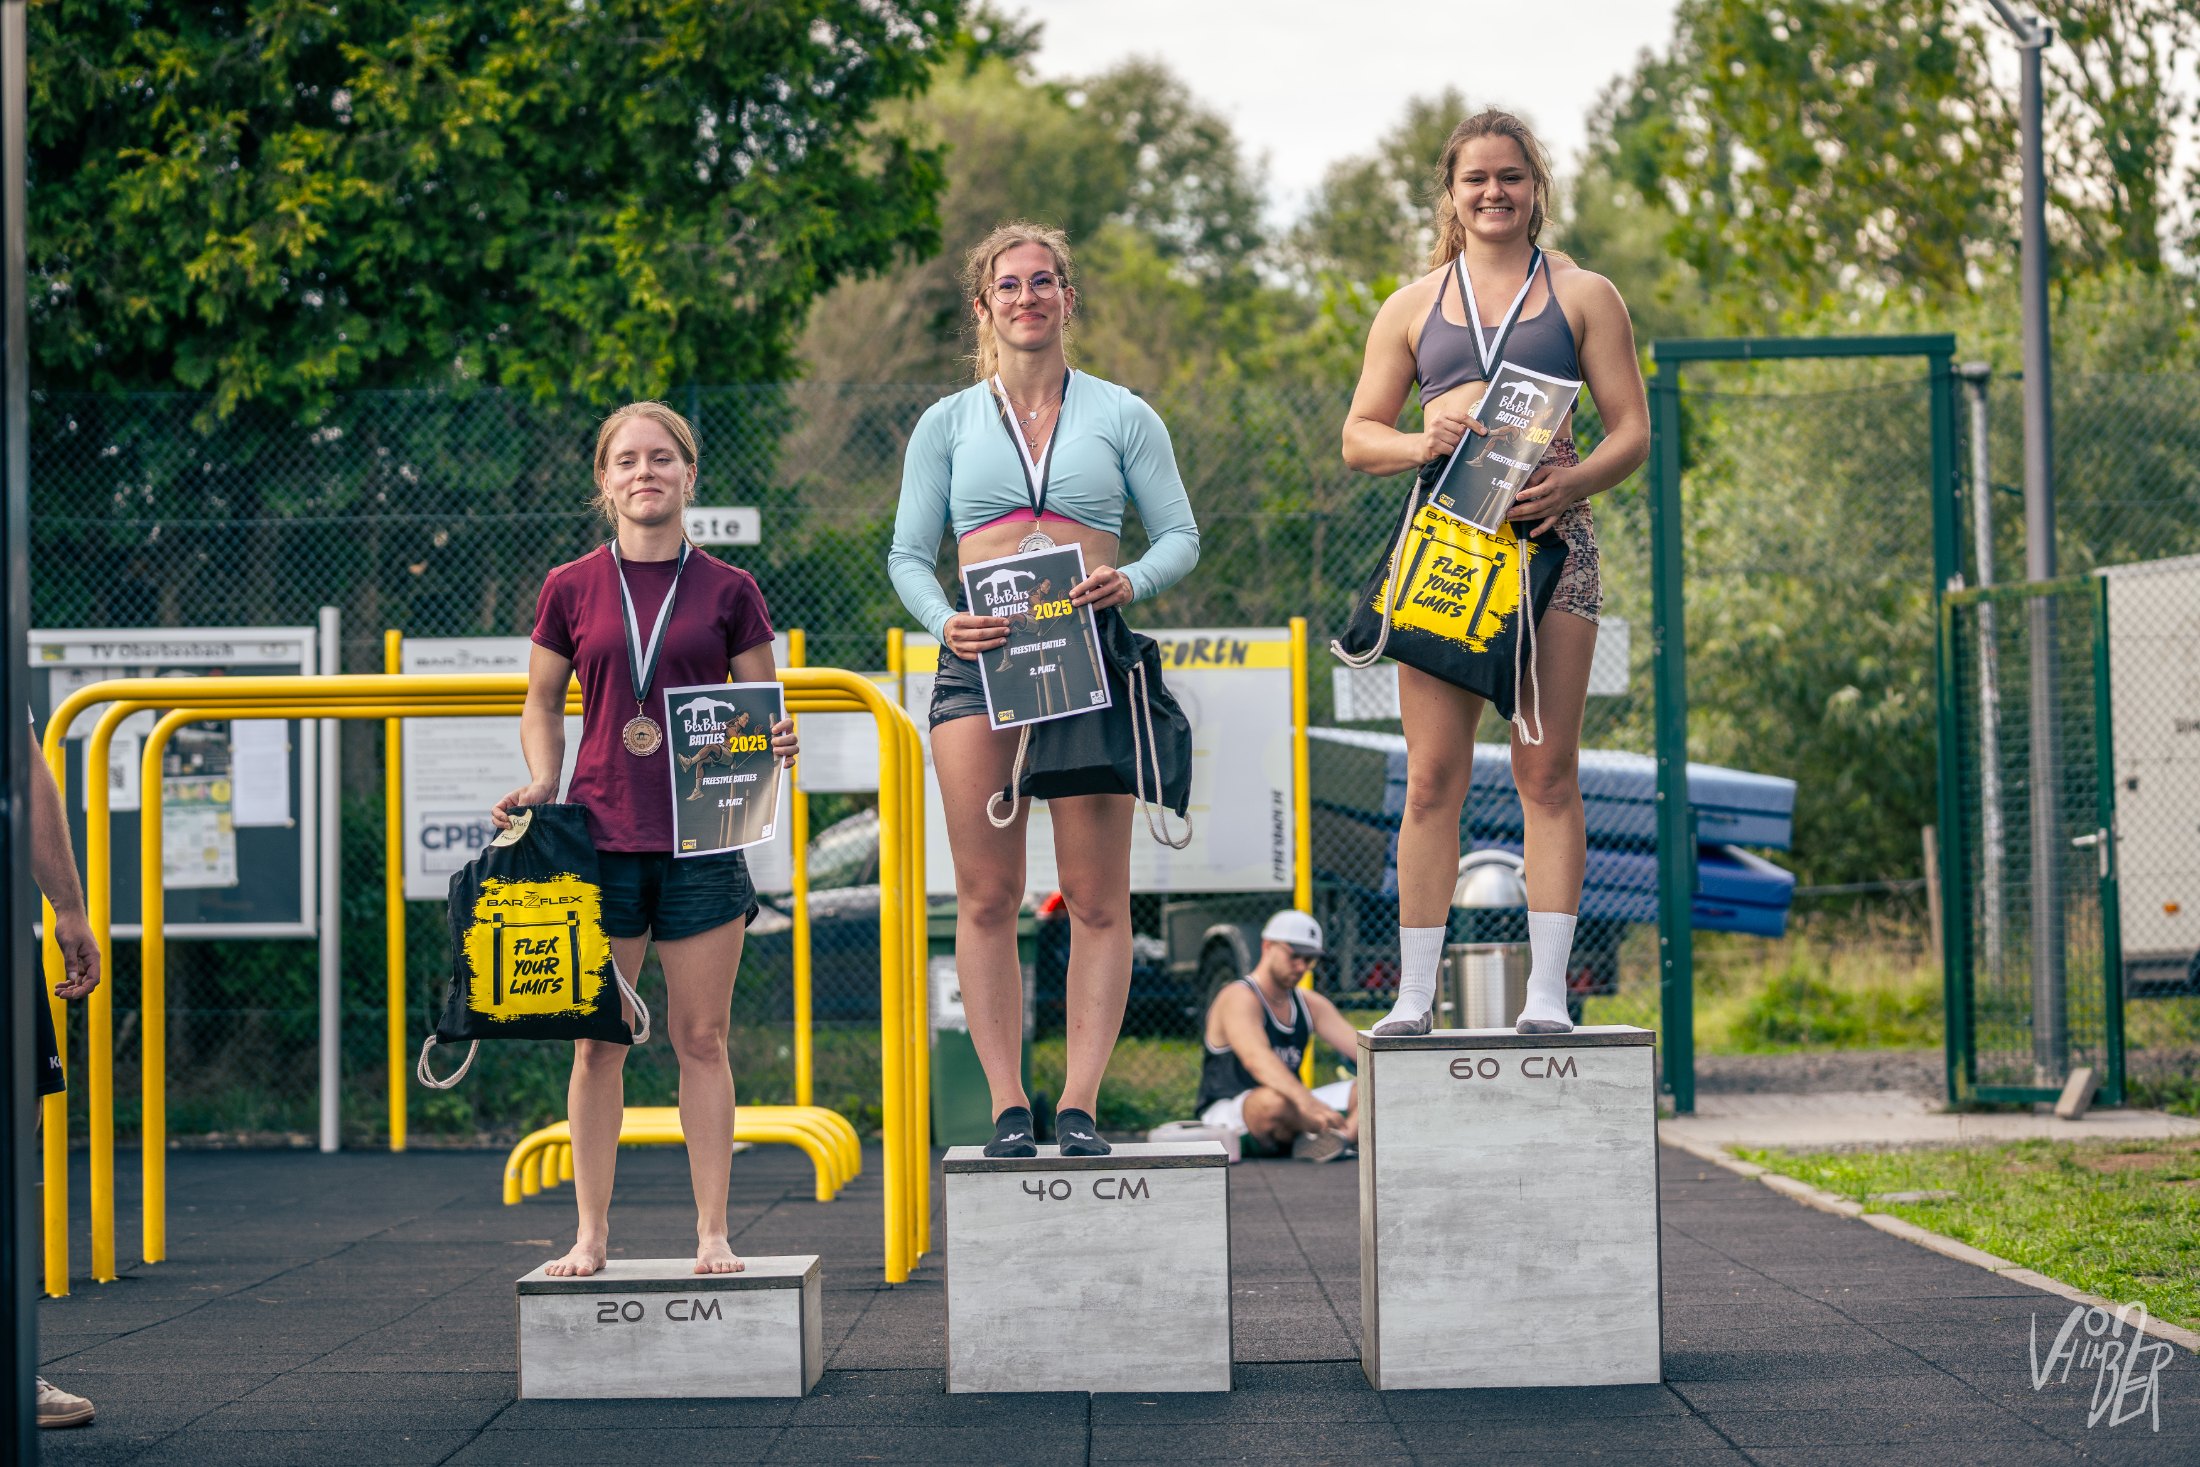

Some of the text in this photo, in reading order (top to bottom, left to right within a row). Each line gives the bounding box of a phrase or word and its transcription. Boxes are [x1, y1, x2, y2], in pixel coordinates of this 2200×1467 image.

[1499, 395, 1535, 418] BexBars
[1495, 411, 1529, 429] BATTLES
[1525, 426, 1552, 444] 2025
[1487, 451, 1515, 467] FREESTYLE
[692, 517, 740, 536] ste
[1432, 555, 1479, 583] FLEX
[1423, 573, 1470, 600] YOUR
[984, 589, 1029, 607] BexBars
[1413, 591, 1466, 618] LIMITS
[992, 602, 1029, 617] BATTLES
[1034, 599, 1073, 621] 2025
[90, 644, 113, 658] TV
[1010, 638, 1066, 655] FREESTYLE BATTLES
[1161, 636, 1249, 667] SOREN
[1029, 664, 1056, 676] 2. PLATZ
[684, 718, 727, 733] BexBars
[689, 732, 725, 746] BATTLES
[730, 735, 767, 752] 2025
[702, 773, 757, 785] FREESTYLE BATTLES
[726, 797, 743, 806] PLATZ
[513, 936, 559, 955] FLEX
[514, 957, 559, 977] YOUR
[510, 977, 564, 995] LIMITS
[1450, 1056, 1577, 1079] 60 CM
[1022, 1177, 1150, 1201] 40 CM
[597, 1298, 722, 1323] 20 CM
